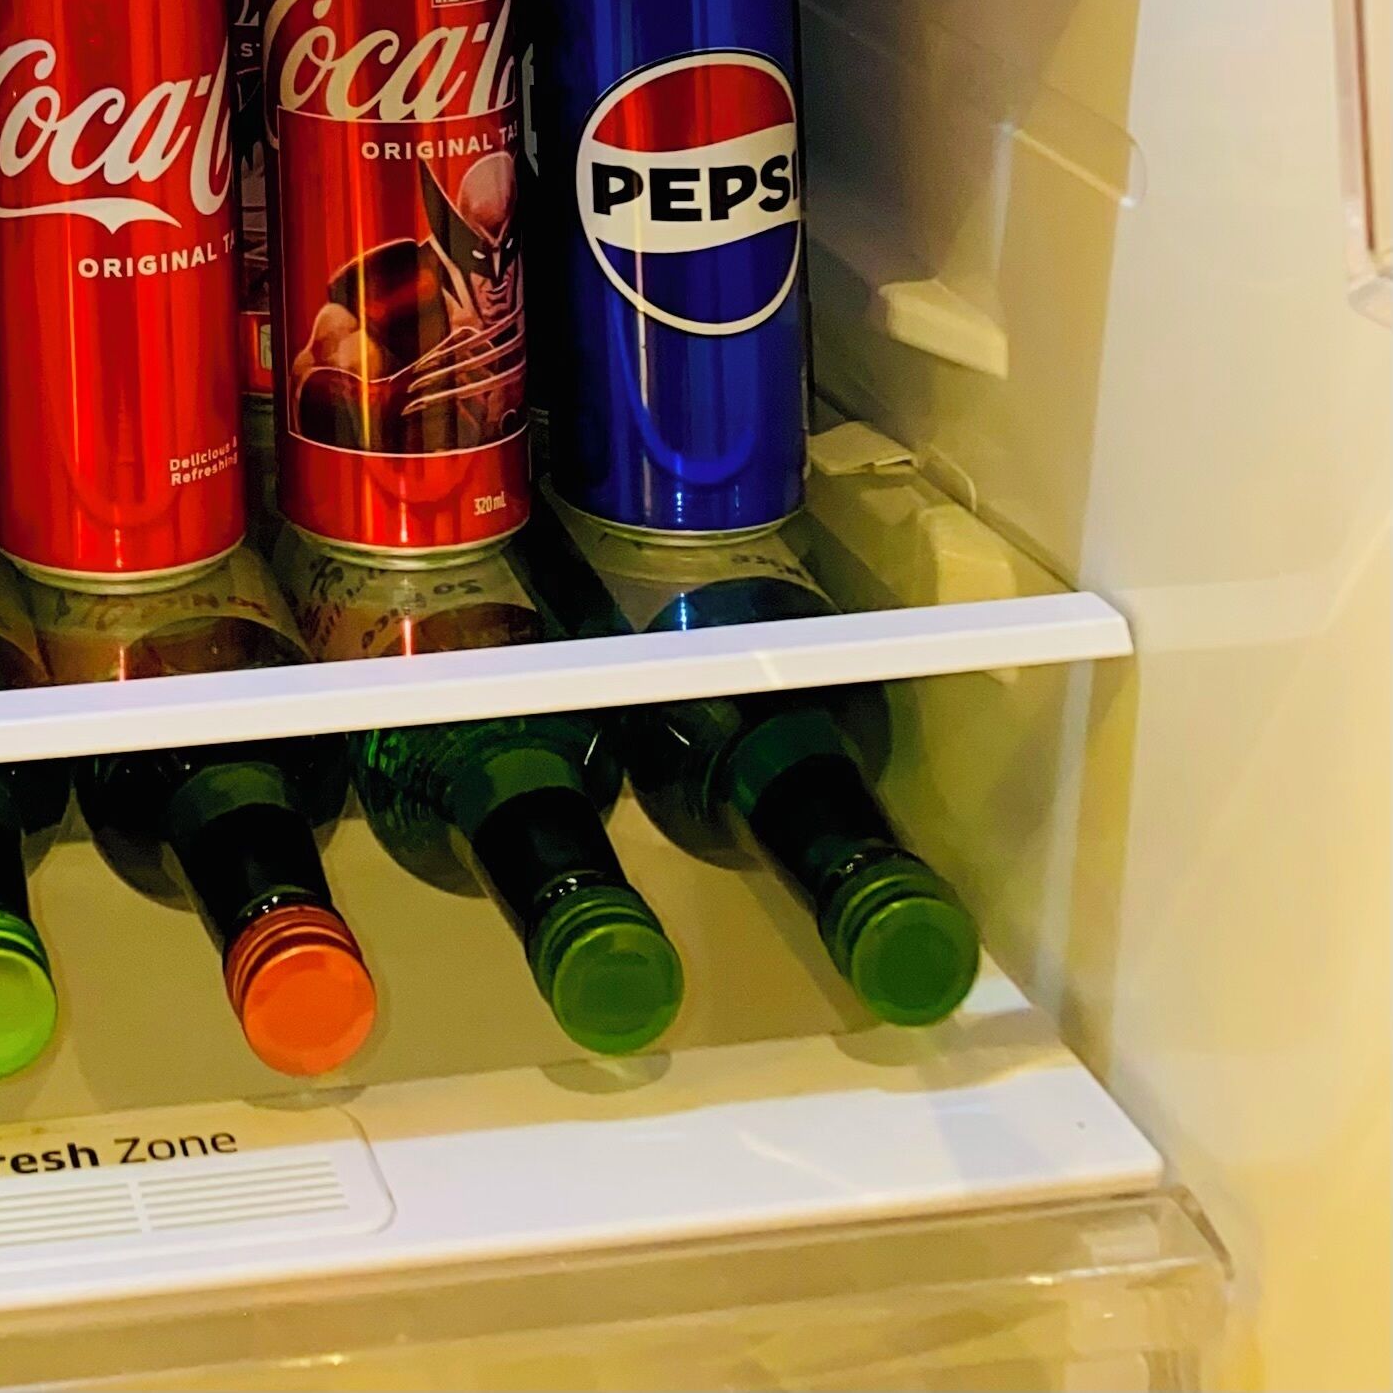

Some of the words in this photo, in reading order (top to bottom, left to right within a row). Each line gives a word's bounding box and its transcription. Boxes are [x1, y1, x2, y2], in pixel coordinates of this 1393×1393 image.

[361, 133, 493, 160] ORIGINAL
[591, 149, 798, 222] PEPSI
[78, 245, 217, 279] ORIGINAL
[169, 442, 231, 472] Delicious
[113, 1132, 238, 1166] Zone
